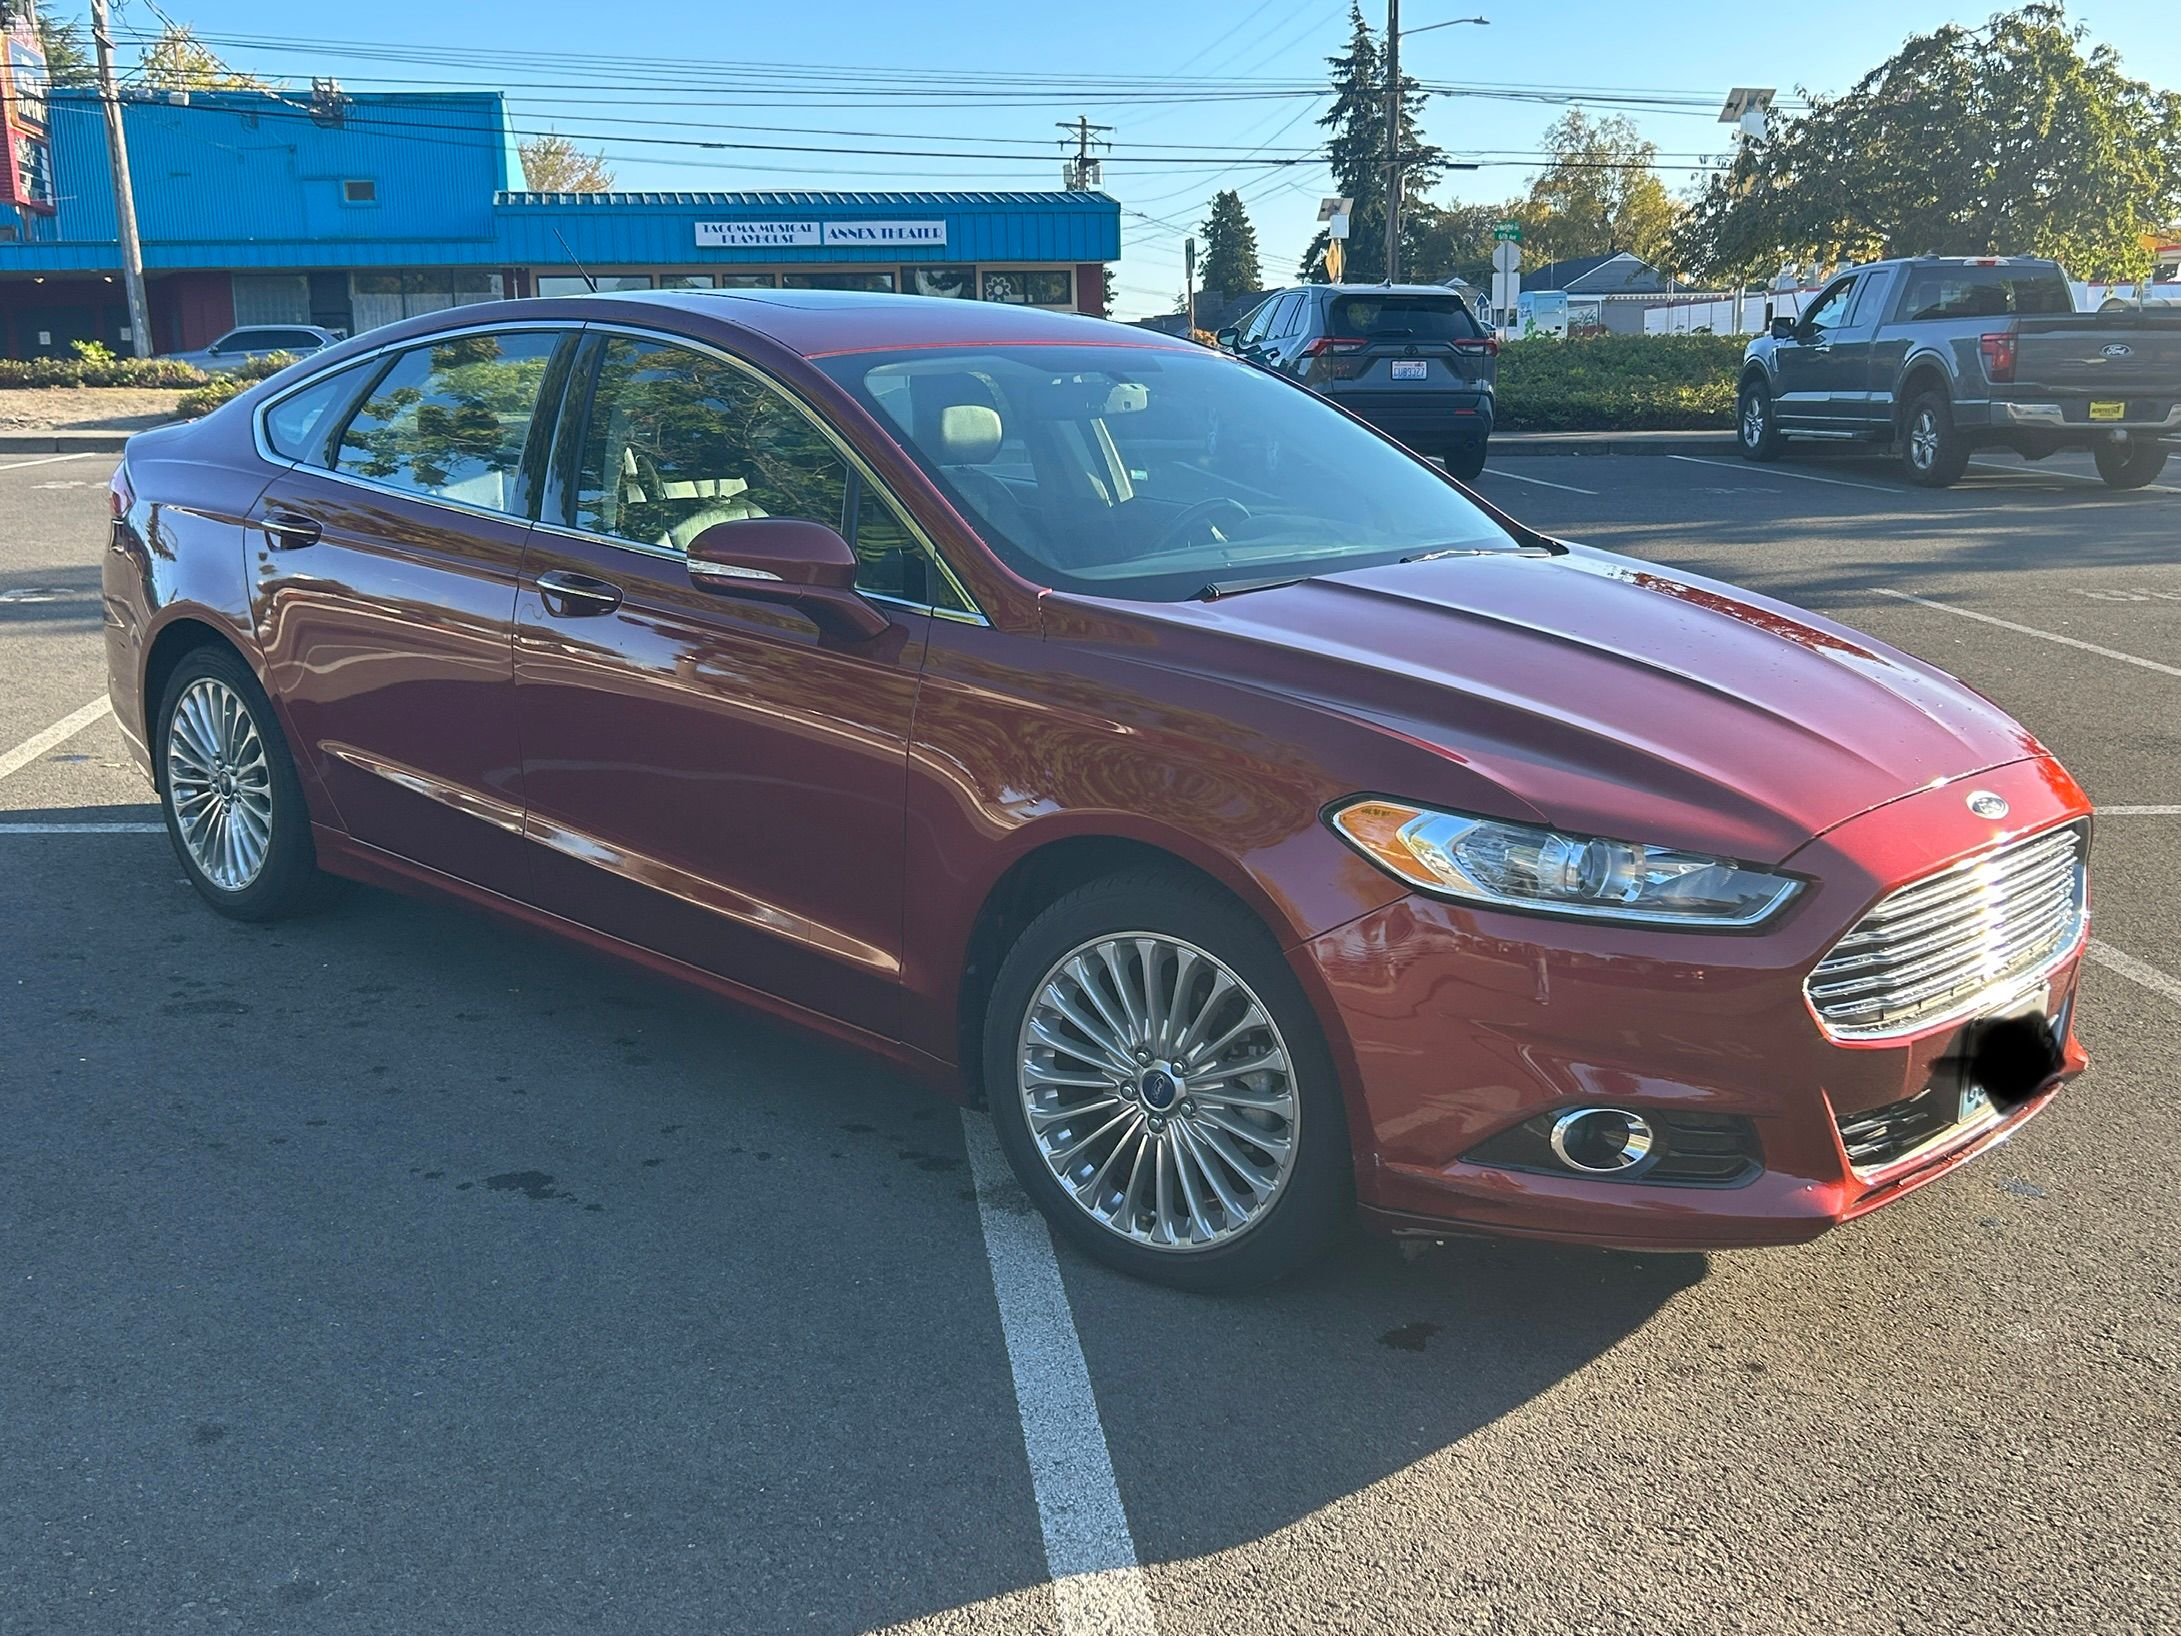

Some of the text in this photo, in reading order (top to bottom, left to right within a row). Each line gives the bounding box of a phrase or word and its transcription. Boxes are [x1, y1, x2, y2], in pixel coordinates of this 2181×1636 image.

[703, 223, 814, 233] TACOMA MUSICAL
[828, 227, 943, 239] ANNEX THEATER
[722, 234, 795, 244] PLAYHOUSE
[2104, 345, 2128, 355] Ford
